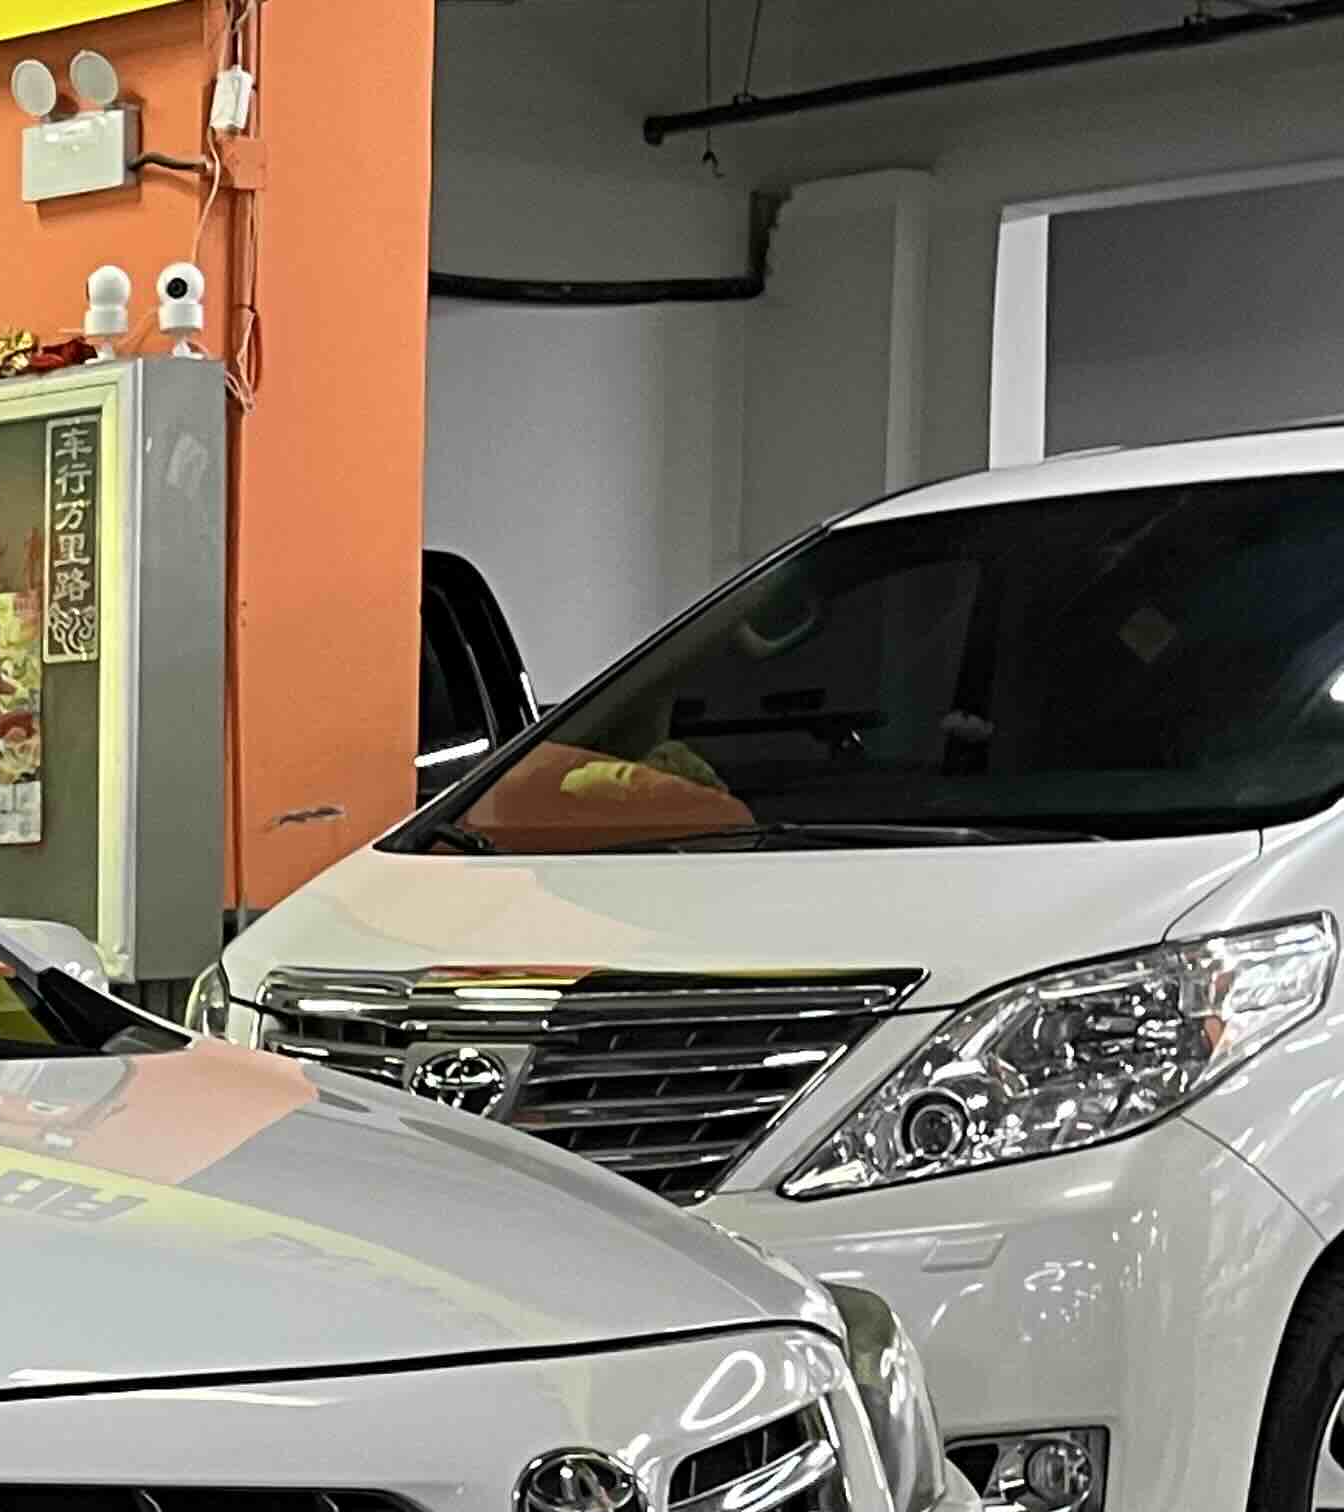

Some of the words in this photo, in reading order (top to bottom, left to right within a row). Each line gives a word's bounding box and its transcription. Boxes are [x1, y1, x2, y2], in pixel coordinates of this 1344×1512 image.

[53, 427, 94, 602] 车行万里路
